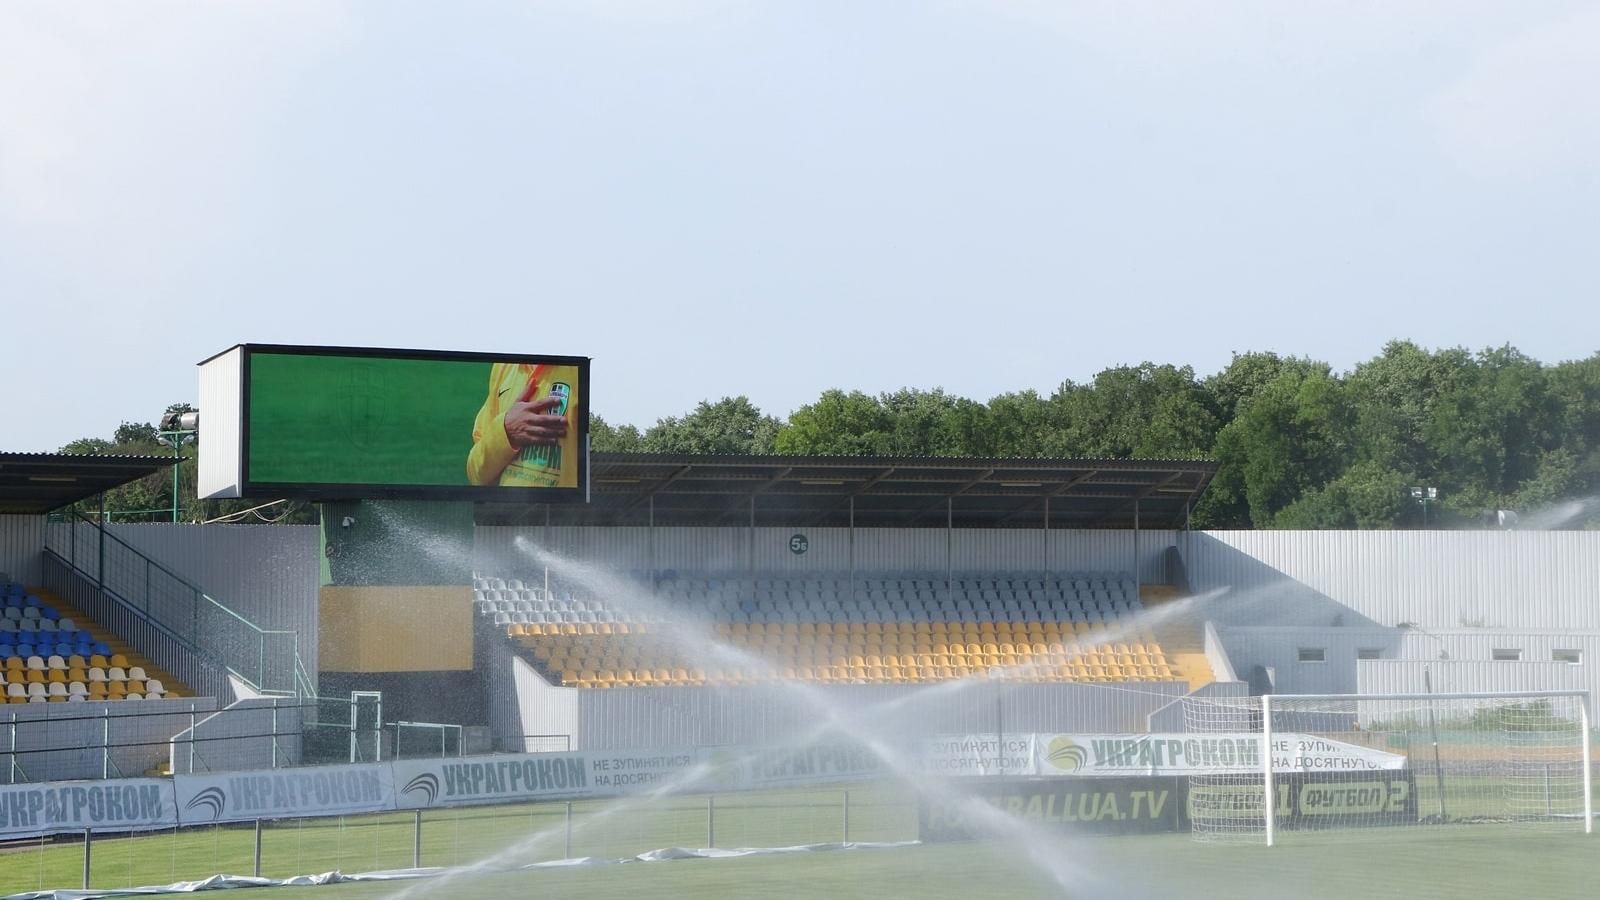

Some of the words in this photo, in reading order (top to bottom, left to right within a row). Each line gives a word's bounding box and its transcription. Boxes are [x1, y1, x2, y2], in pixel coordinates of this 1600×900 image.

[933, 740, 1028, 753] ЗУПИНЯТИСЯ
[1091, 739, 1259, 767] УКРАГРОКОМ
[593, 760, 609, 771] НЕ
[612, 755, 690, 770] ЗУПИНЯТИСЯ
[1271, 759, 1290, 768] НА
[442, 757, 586, 796] УКРАГРОКОМ
[595, 776, 613, 786] НА
[615, 772, 674, 787] ДОСЯГНУТ
[229, 769, 382, 811] УКРАГРОКОМ
[1305, 788, 1381, 809] ФУТБОЛ
[1385, 781, 1409, 811] 2
